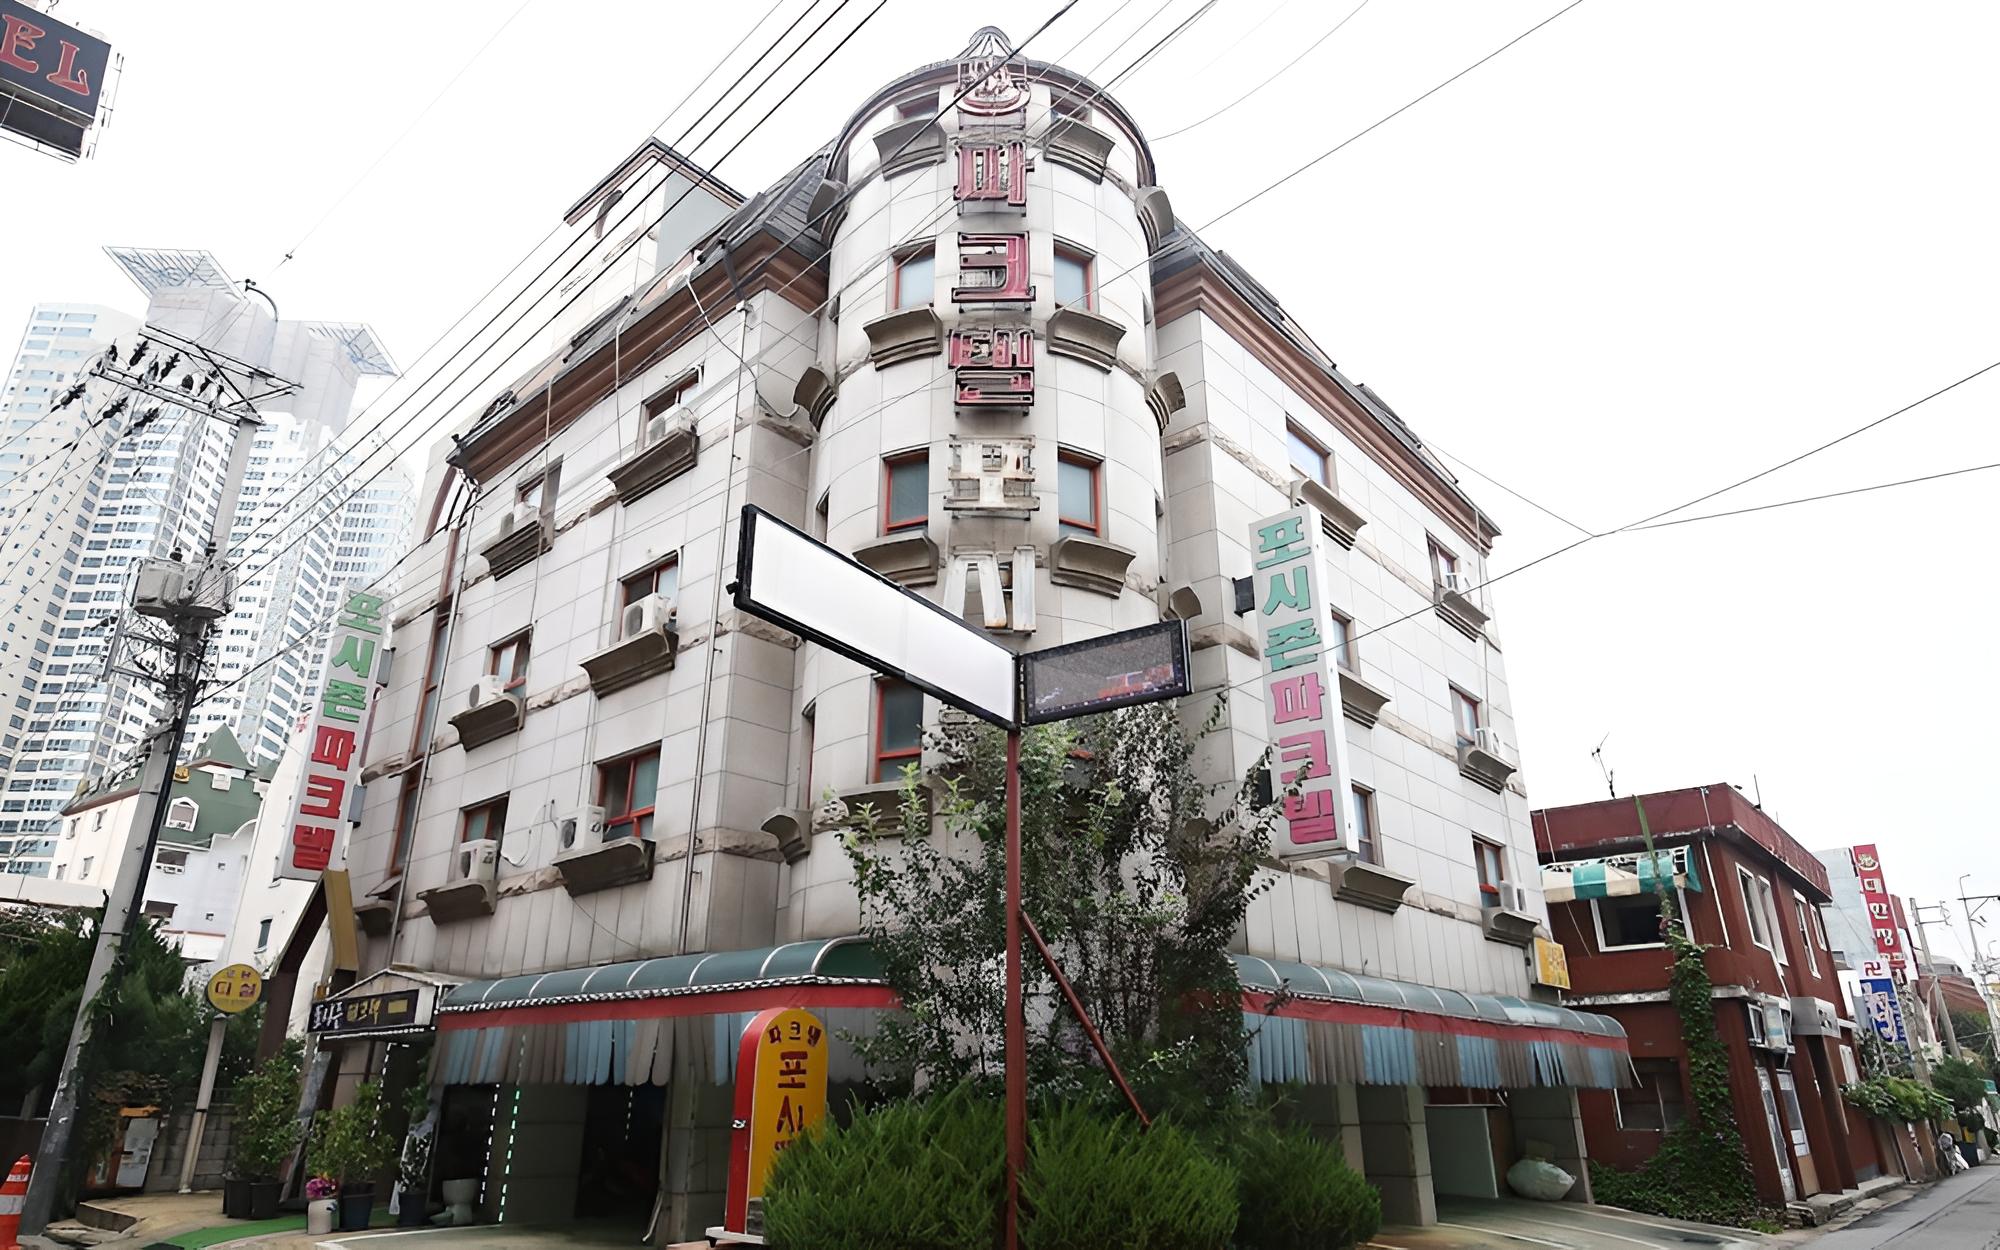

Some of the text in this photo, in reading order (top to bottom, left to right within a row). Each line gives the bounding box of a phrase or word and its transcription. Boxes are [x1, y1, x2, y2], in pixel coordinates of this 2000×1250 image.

[321, 589, 384, 723] 포시즌
[1256, 516, 1337, 844] 포시즌 파크텔
[774, 1051, 808, 1151] 포시
